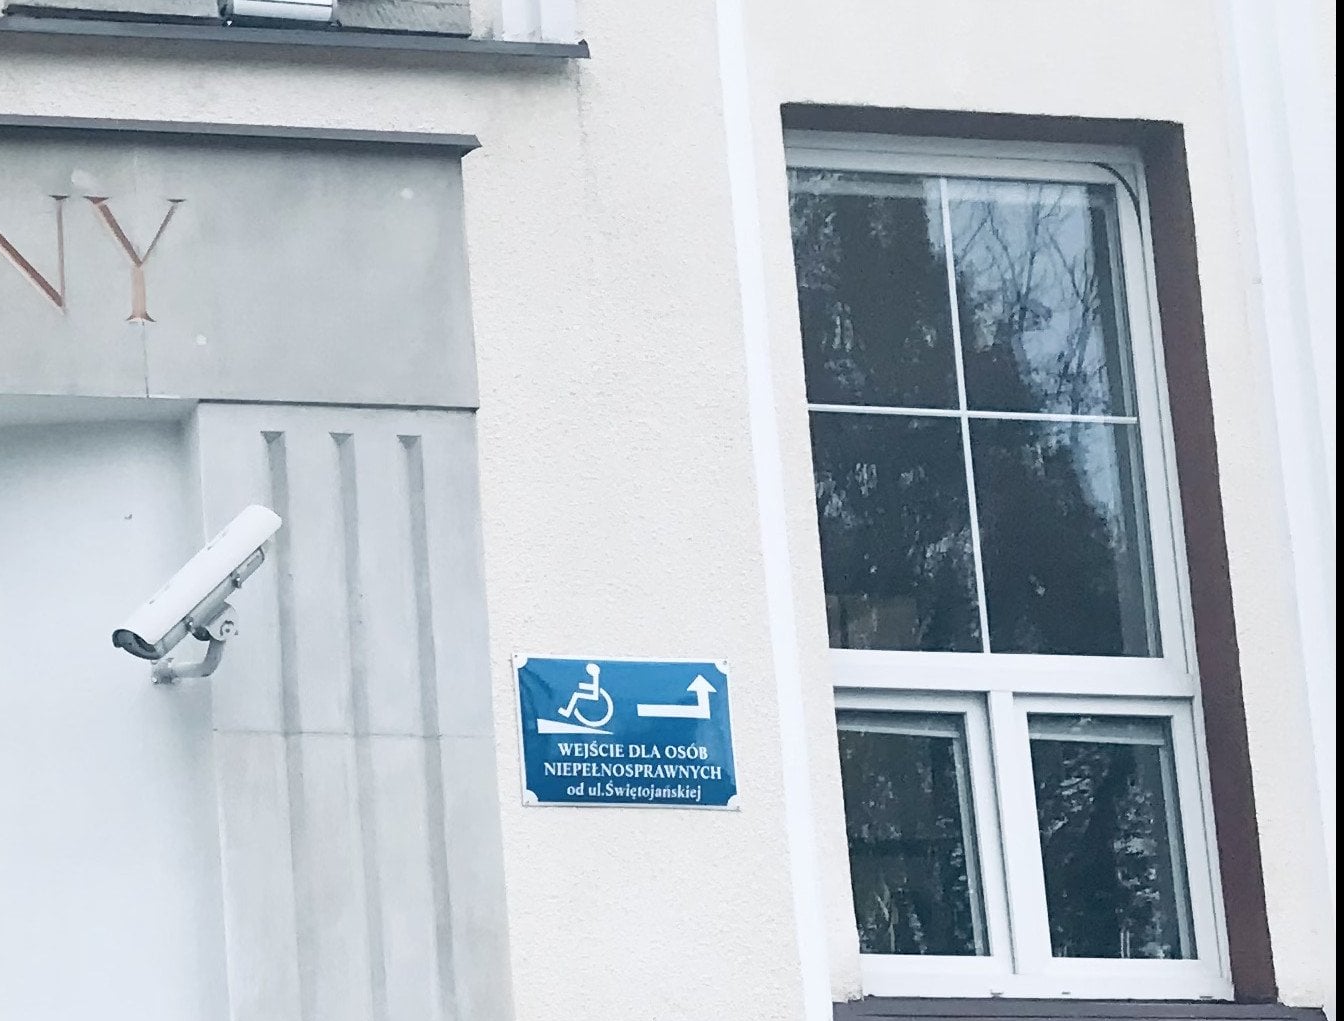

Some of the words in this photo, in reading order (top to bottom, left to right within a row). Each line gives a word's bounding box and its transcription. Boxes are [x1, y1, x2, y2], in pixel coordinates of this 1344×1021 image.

[558, 740, 624, 759] WEJŚCIE
[629, 744, 661, 759] DLA
[664, 743, 708, 760] OSÓB
[544, 762, 722, 780] NIEPEŁNOSPRAWNYCH
[567, 782, 584, 796] od
